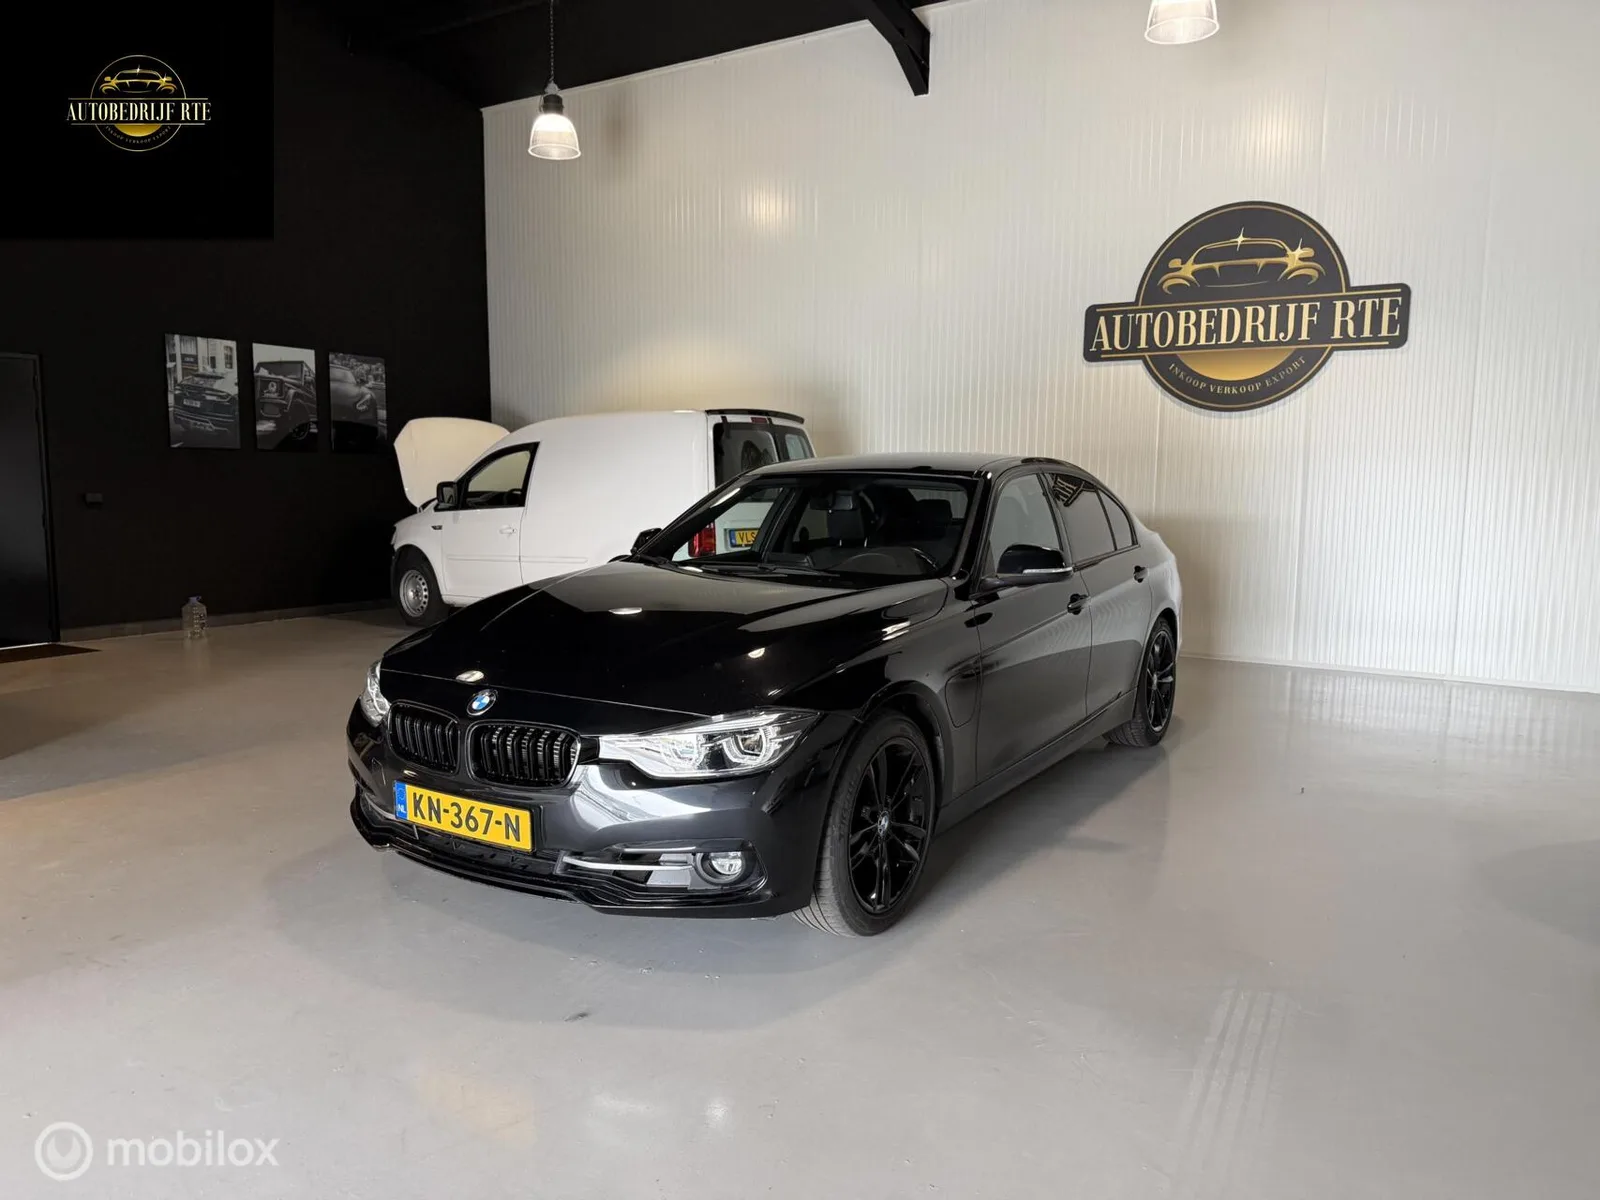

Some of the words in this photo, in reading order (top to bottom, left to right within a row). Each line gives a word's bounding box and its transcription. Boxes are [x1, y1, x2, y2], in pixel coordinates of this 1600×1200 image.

[1089, 301, 1320, 352] AUTOBEDRIJF
[1330, 297, 1402, 339] RTE
[1168, 363, 1207, 389] INKOOP
[1209, 383, 1262, 394] VERKOOP
[1265, 356, 1306, 387] EXPORT
[412, 792, 521, 842] KN-367-N
